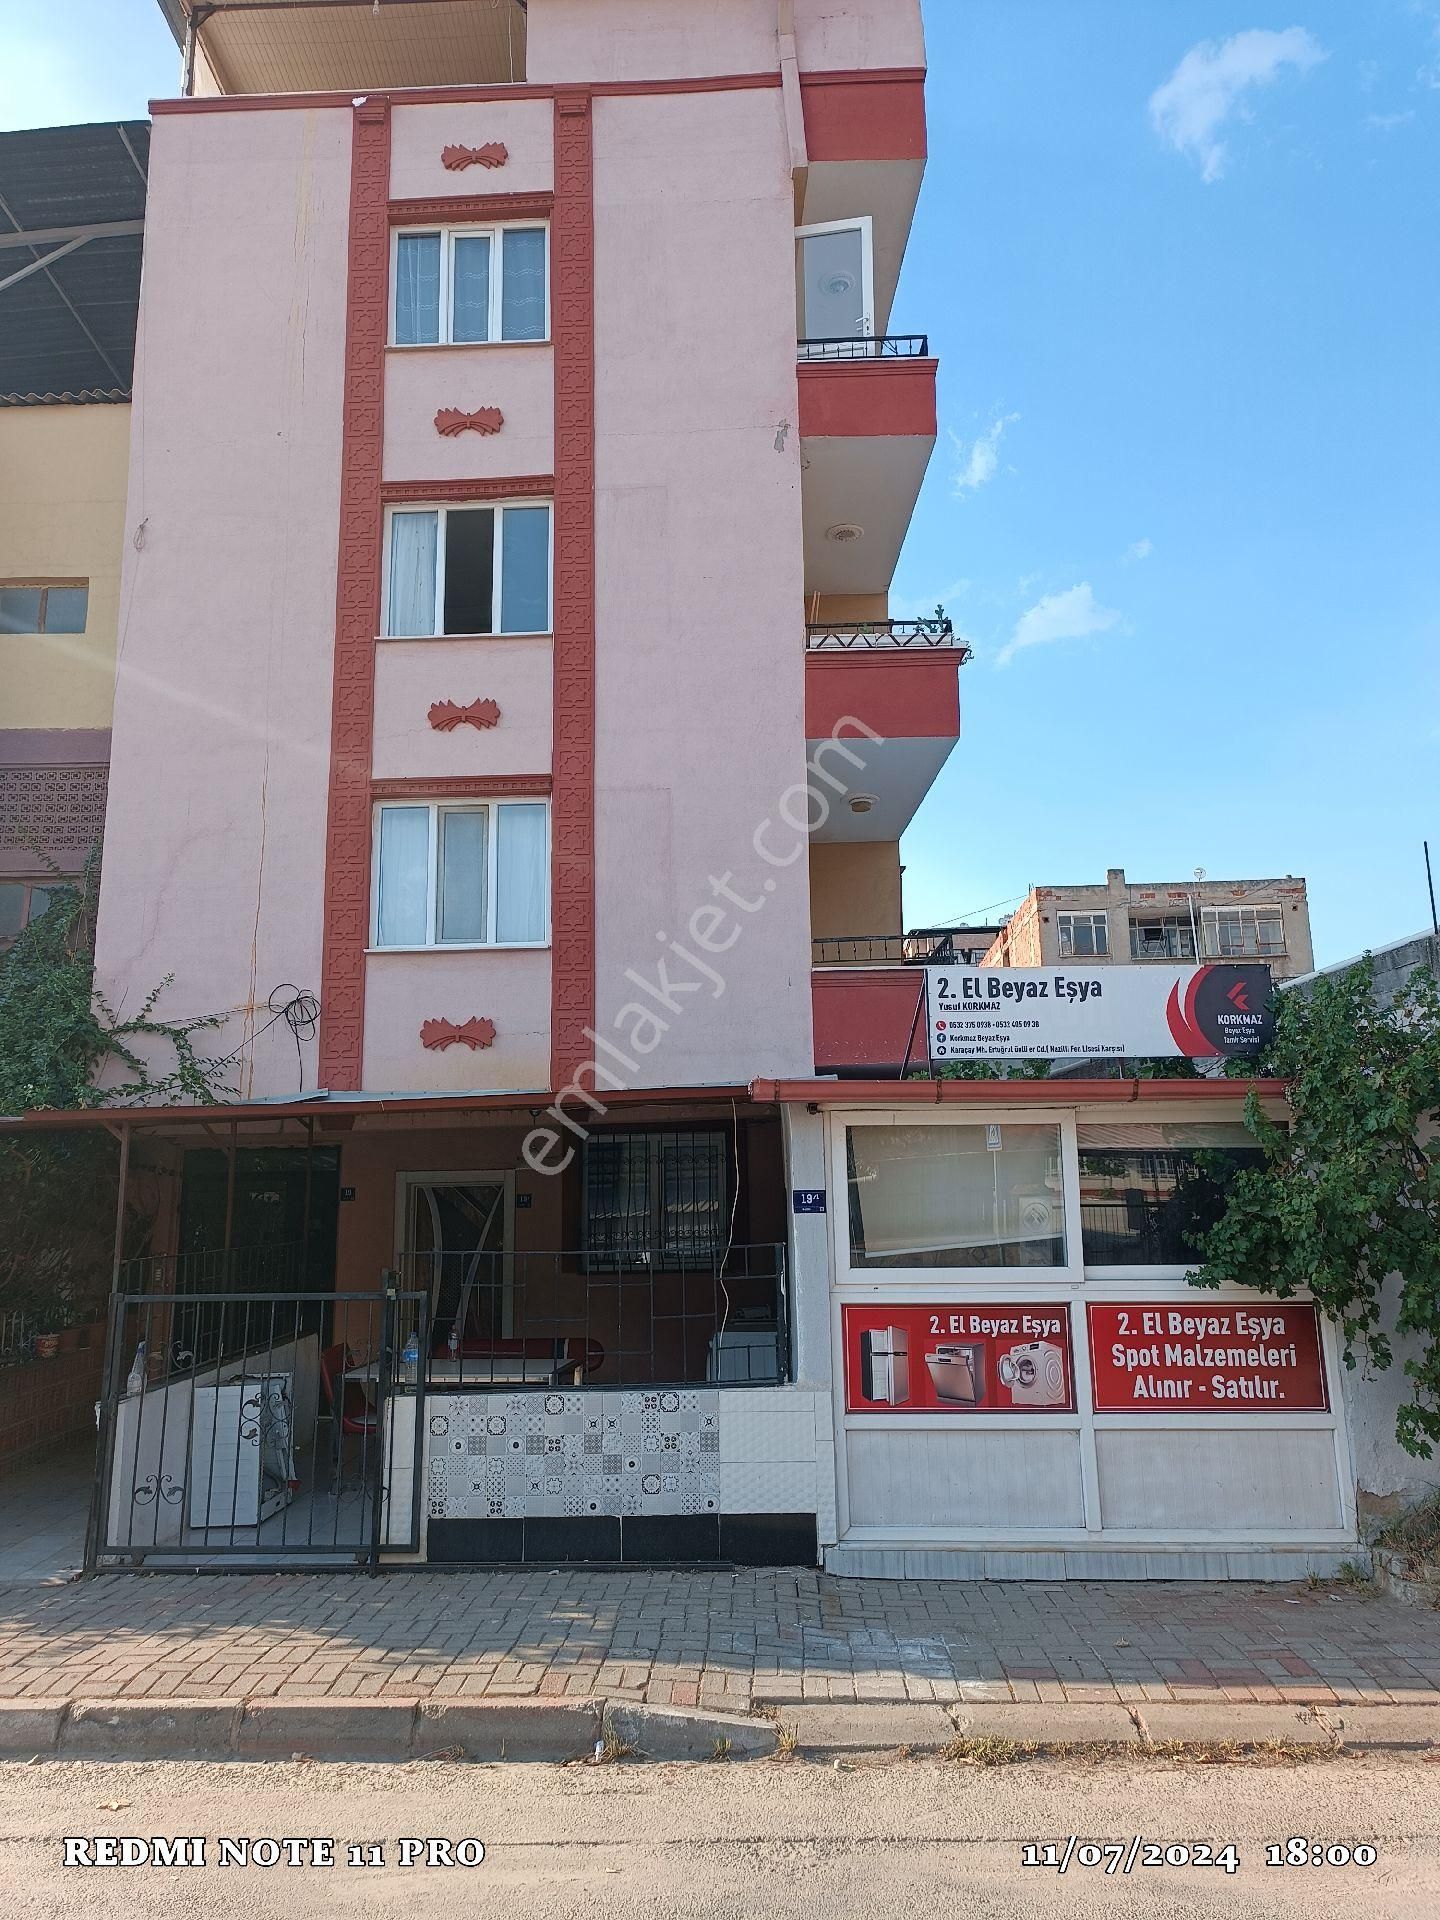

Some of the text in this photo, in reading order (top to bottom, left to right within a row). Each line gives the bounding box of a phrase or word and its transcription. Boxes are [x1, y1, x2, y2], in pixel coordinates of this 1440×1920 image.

[937, 976, 1102, 1003] 2. El Beyaz Eşya
[939, 1001, 1001, 1011] Yusuf KORKMAZ
[1217, 1014, 1263, 1025] KORKMAZ
[950, 1045, 975, 1055] Karaçay
[929, 1315, 1061, 1338] 2. El Beyaz Eşya
[1117, 1311, 1286, 1342] 2. El Beyaz Eşya
[1111, 1343, 1297, 1372] Spot Malzemeleri
[1133, 1374, 1193, 1399] Alınır
[1211, 1374, 1286, 1399] Satılır.
